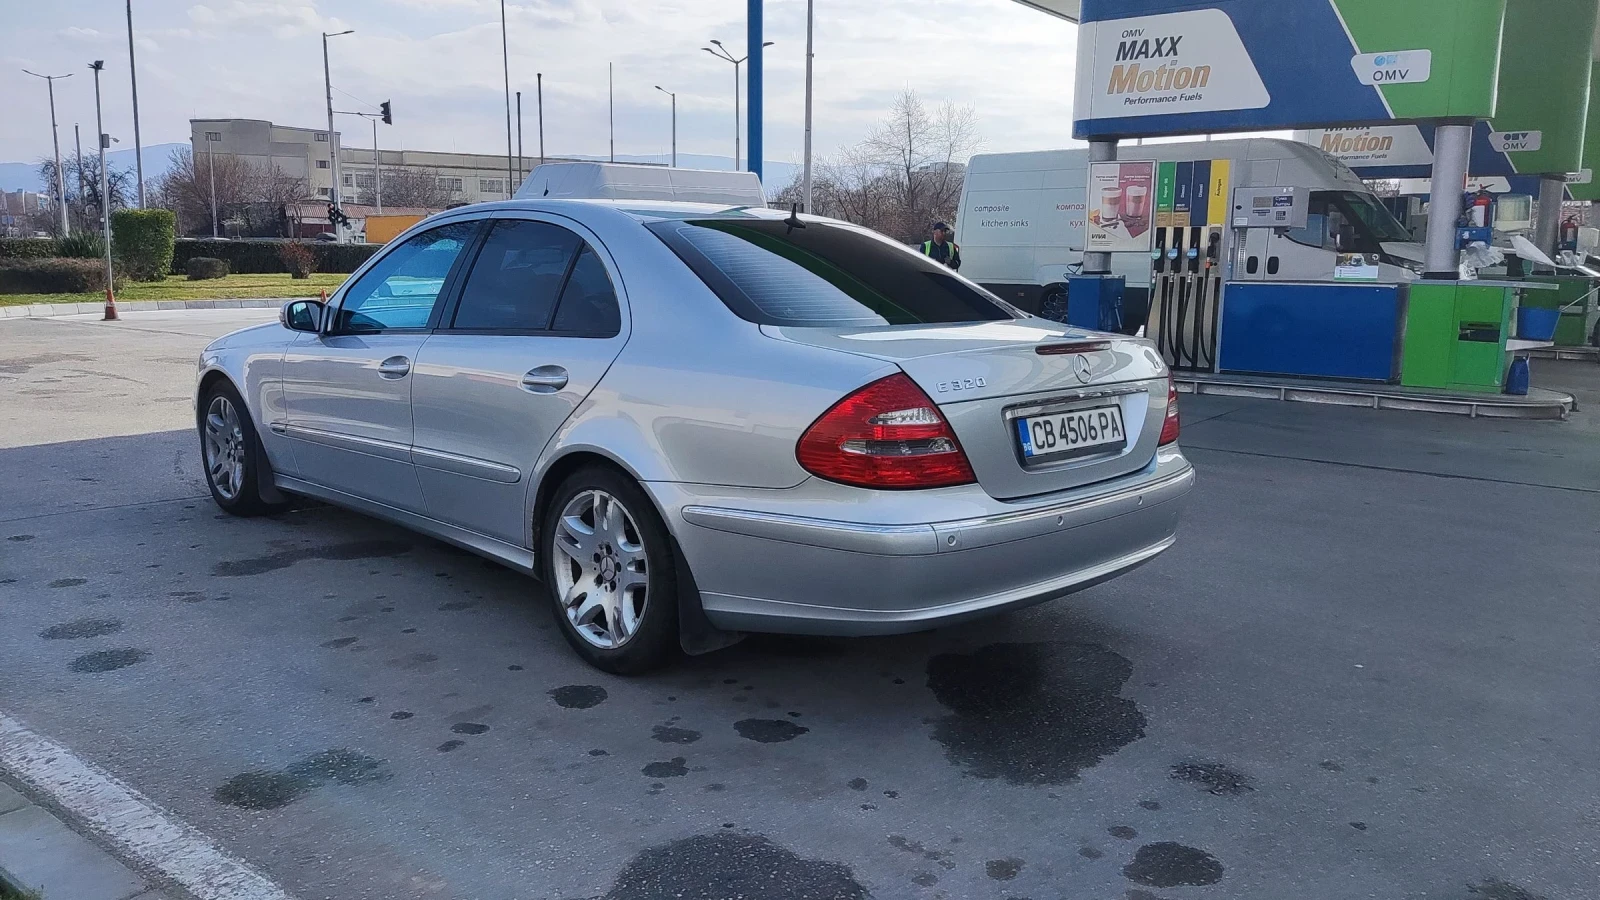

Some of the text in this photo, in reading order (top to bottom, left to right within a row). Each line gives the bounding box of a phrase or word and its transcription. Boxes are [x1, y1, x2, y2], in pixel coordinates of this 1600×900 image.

[1122, 29, 1144, 38] OMV
[1116, 36, 1182, 61] MAXX
[1107, 60, 1211, 94] Motion
[1372, 68, 1410, 82] OMV
[1124, 93, 1202, 105] Performance Fuels
[1320, 131, 1393, 153] Motion
[1502, 142, 1528, 150] OMV
[974, 204, 1010, 213] composite
[981, 219, 1029, 228] kitchen sinks
[936, 376, 987, 393] E 320
[1032, 411, 1121, 449] CB 4506 PA
[1023, 442, 1032, 452] BG
